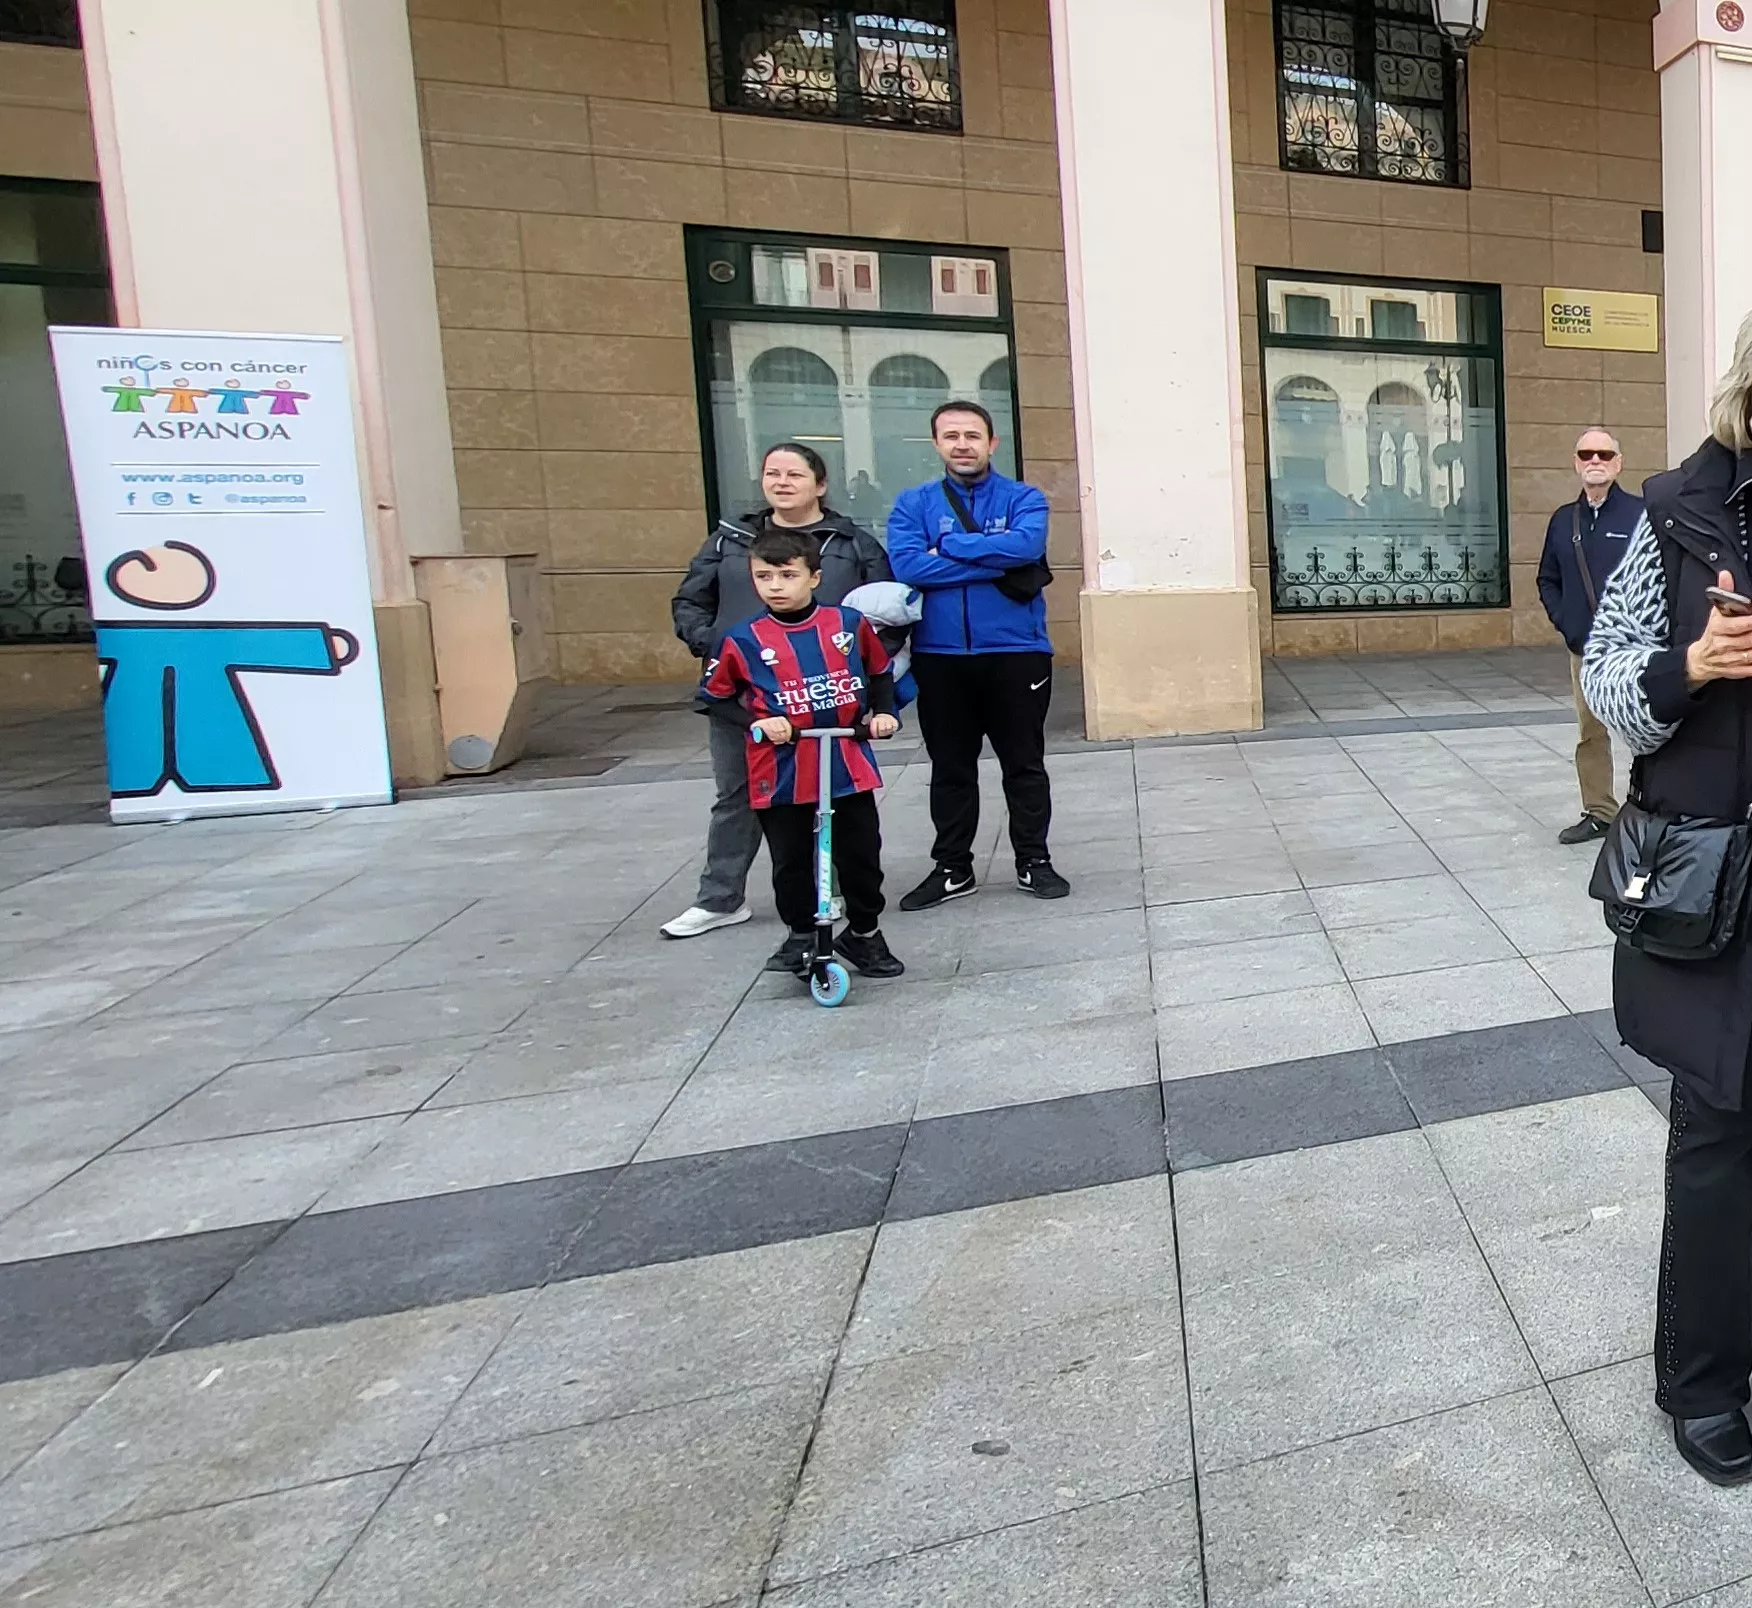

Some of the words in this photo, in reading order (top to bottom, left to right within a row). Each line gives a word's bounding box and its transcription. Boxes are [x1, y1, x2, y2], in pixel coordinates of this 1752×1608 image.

[1551, 303, 1591, 317] CEOE
[1551, 317, 1591, 326] CEPYME
[1551, 325, 1592, 334] HUESCA
[180, 360, 222, 372] con
[230, 360, 308, 374] cáncer
[133, 421, 292, 440] ASPANOA
[121, 473, 304, 485] www.aspanoa.org
